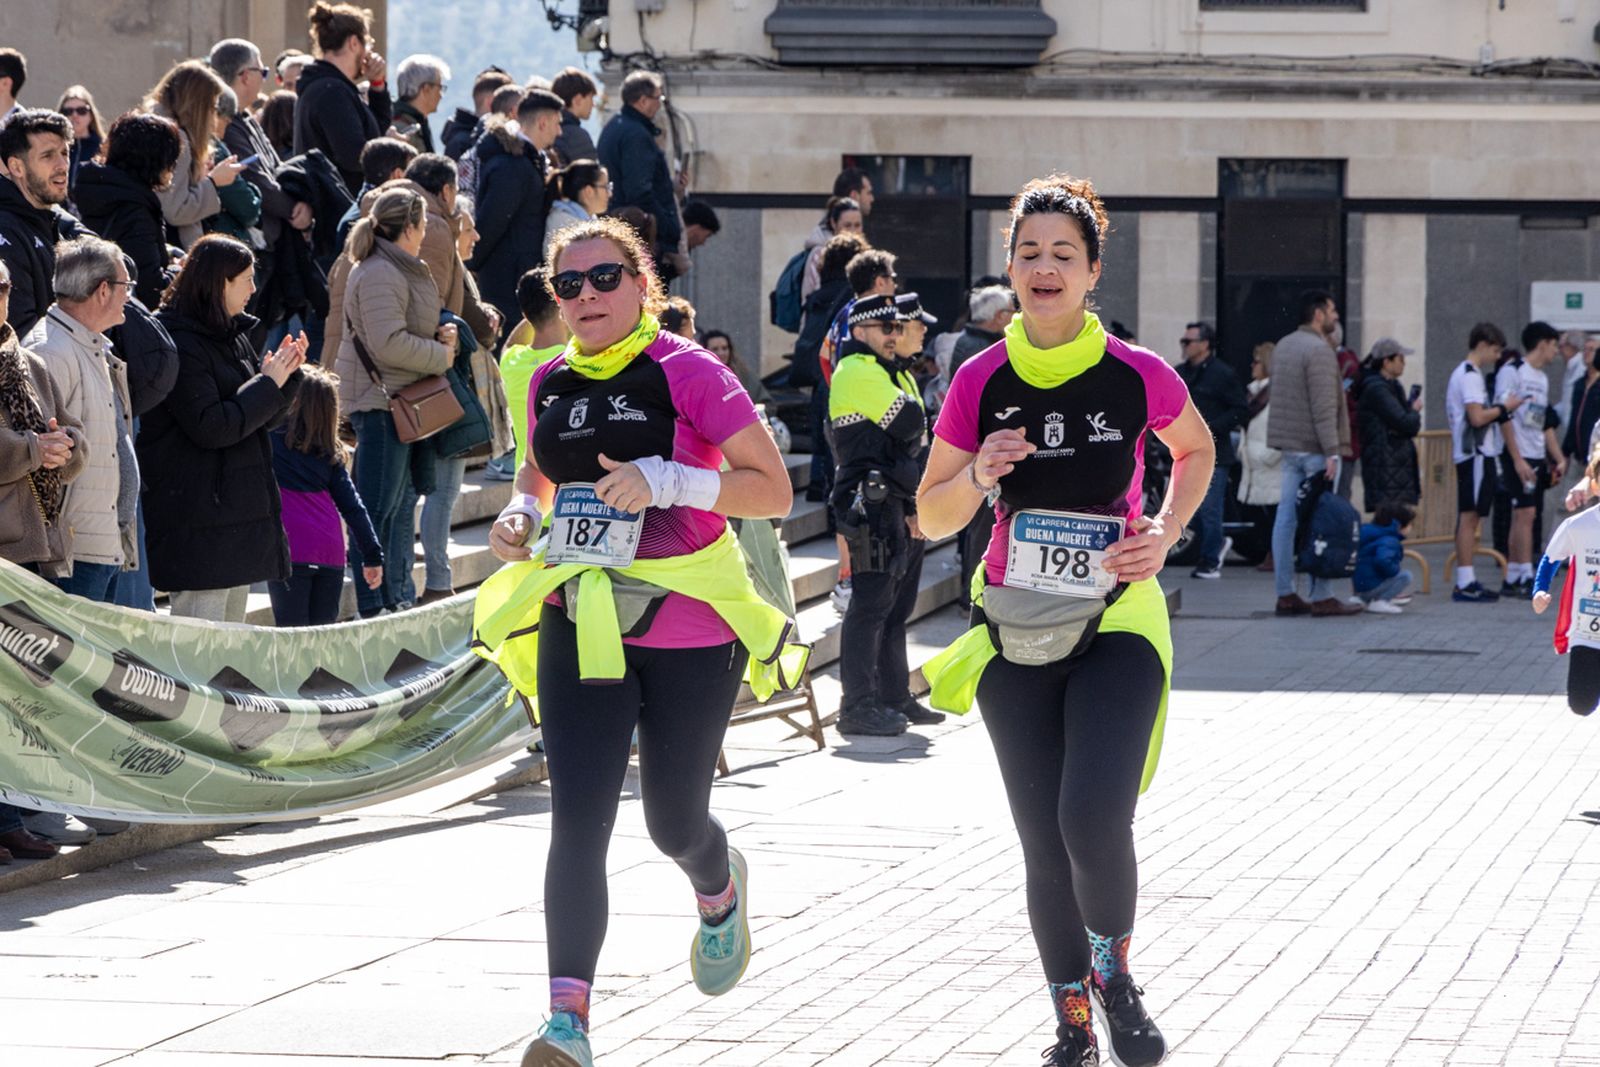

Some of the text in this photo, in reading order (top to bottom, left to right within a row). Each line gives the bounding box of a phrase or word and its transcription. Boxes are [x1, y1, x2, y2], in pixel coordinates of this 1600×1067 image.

[560, 502, 611, 515] BUENA MUERTE
[566, 518, 611, 546] 187
[1025, 528, 1092, 546] BUENA MUERTE
[1026, 517, 1109, 532] VI CARRERA CAMINATA
[1040, 545, 1090, 579] 198
[120, 663, 177, 701] ownat
[120, 745, 186, 776] VERDAD
